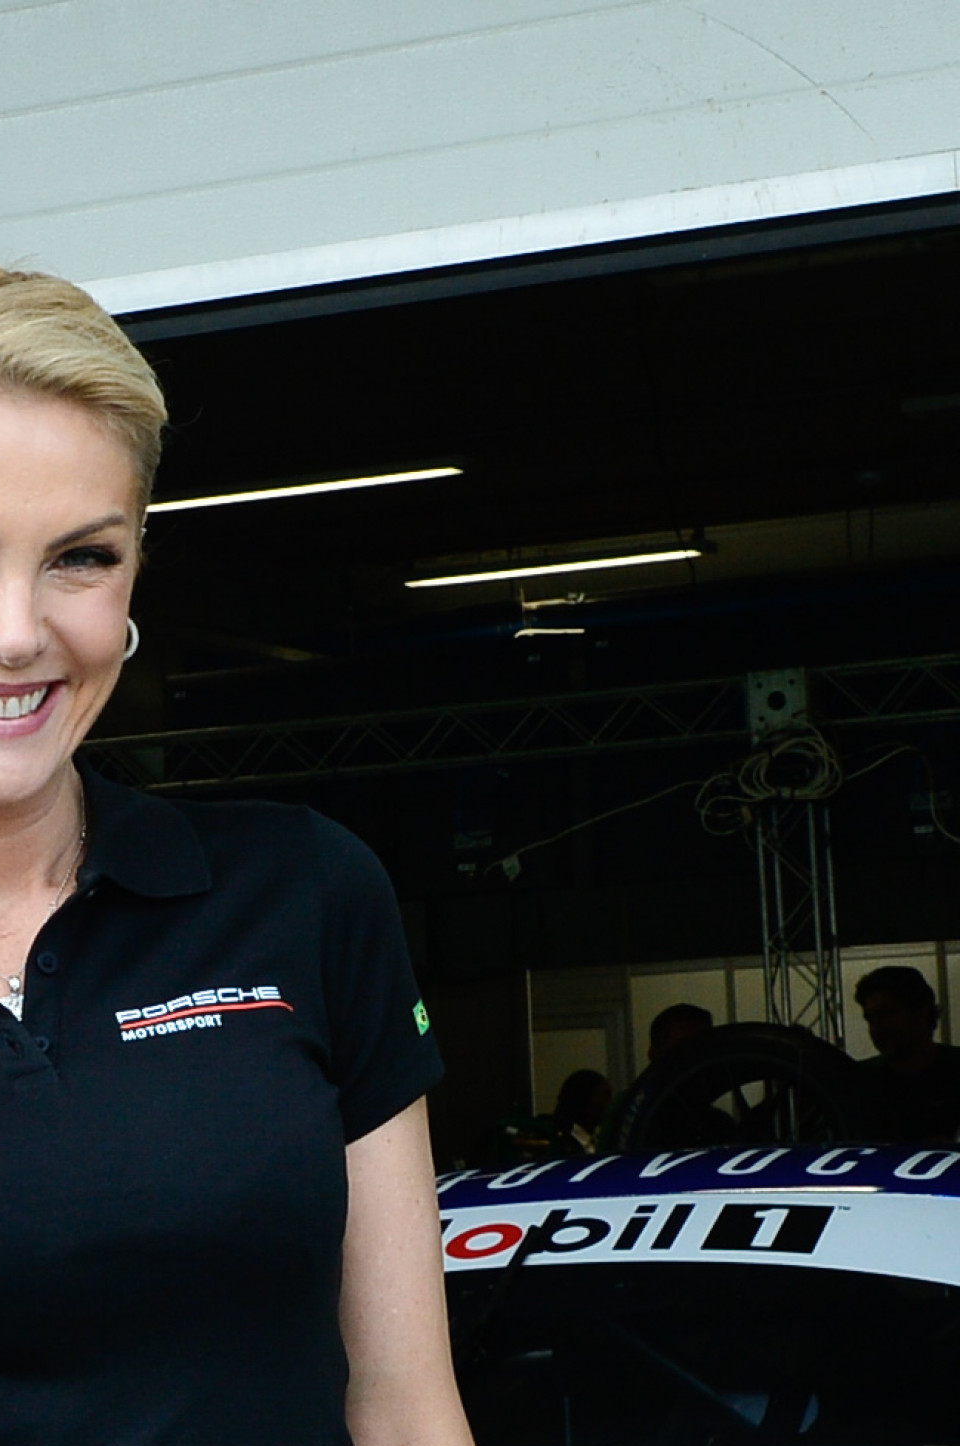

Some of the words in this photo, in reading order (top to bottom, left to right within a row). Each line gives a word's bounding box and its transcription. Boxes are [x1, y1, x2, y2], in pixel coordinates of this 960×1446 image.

[115, 986, 281, 1024] PORSCHE
[121, 1014, 223, 1042] MOTORSPORT
[440, 1203, 696, 1260] obil
